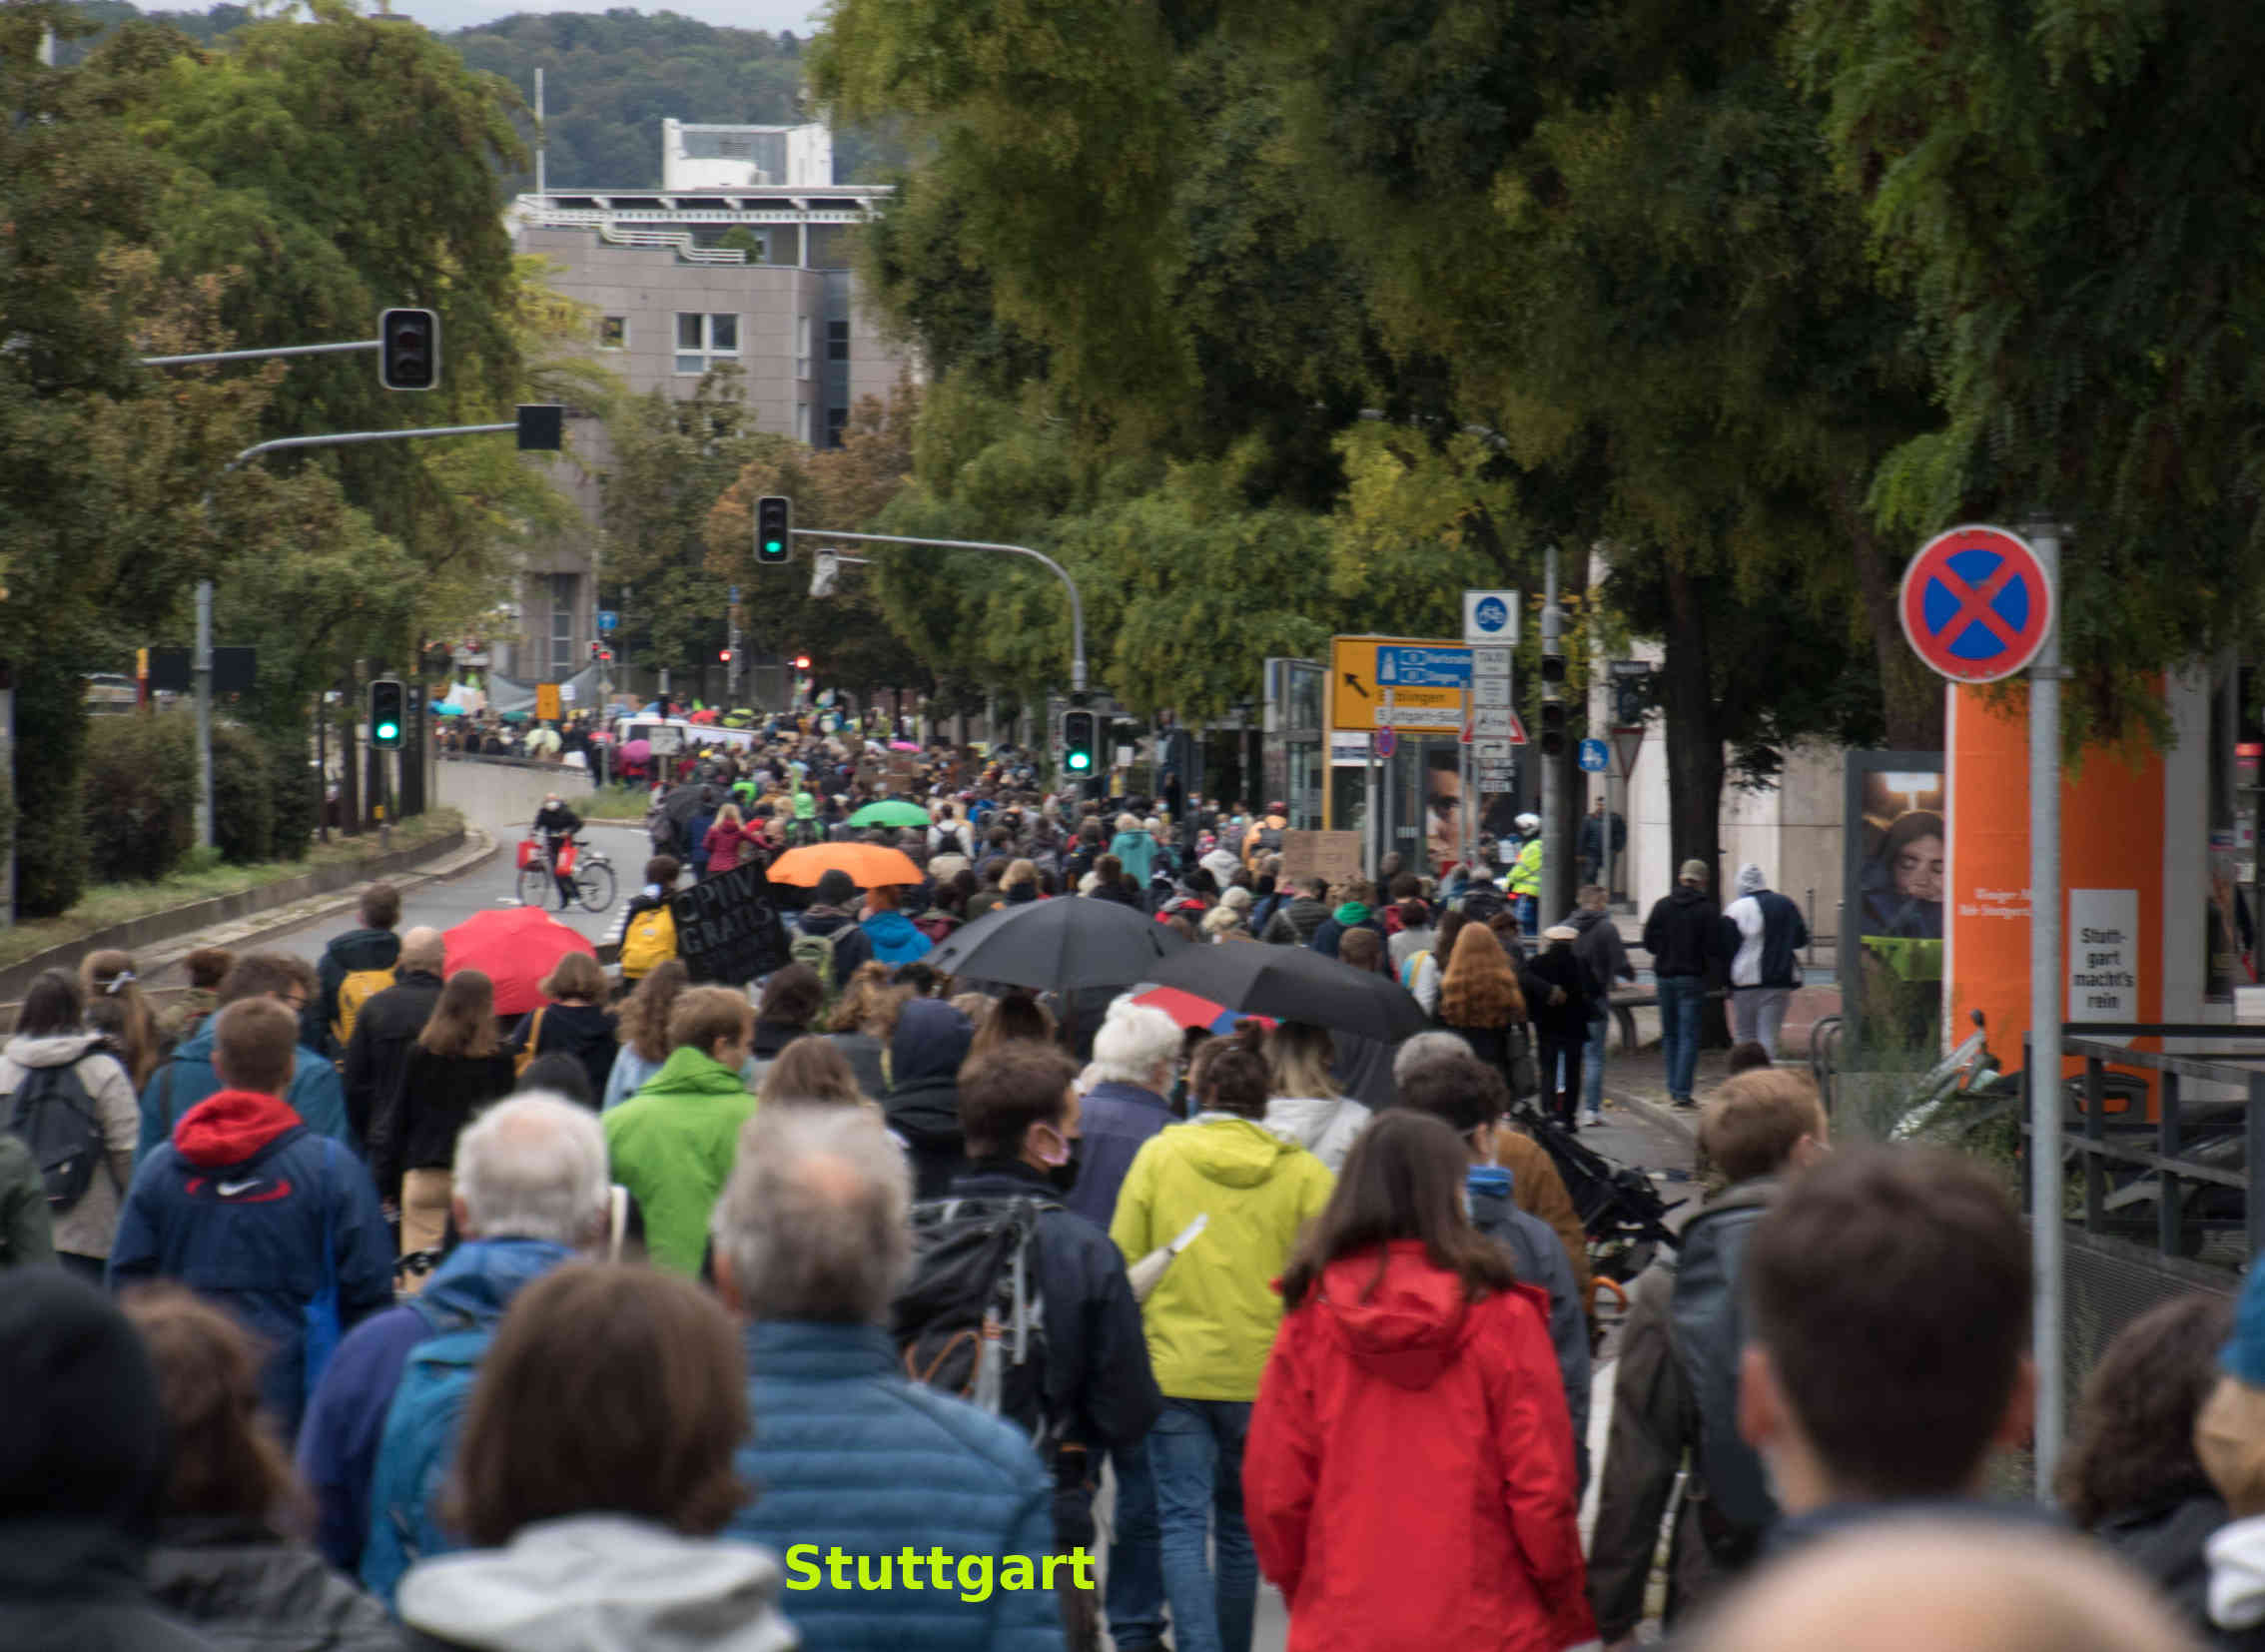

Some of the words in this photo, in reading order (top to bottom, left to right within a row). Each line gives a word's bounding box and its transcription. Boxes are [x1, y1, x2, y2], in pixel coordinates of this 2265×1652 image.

[2080, 927, 2127, 944] Stutt-
[2086, 951, 2120, 968] gart
[2073, 970, 2134, 987] macht's
[2086, 993, 2119, 1008] rein
